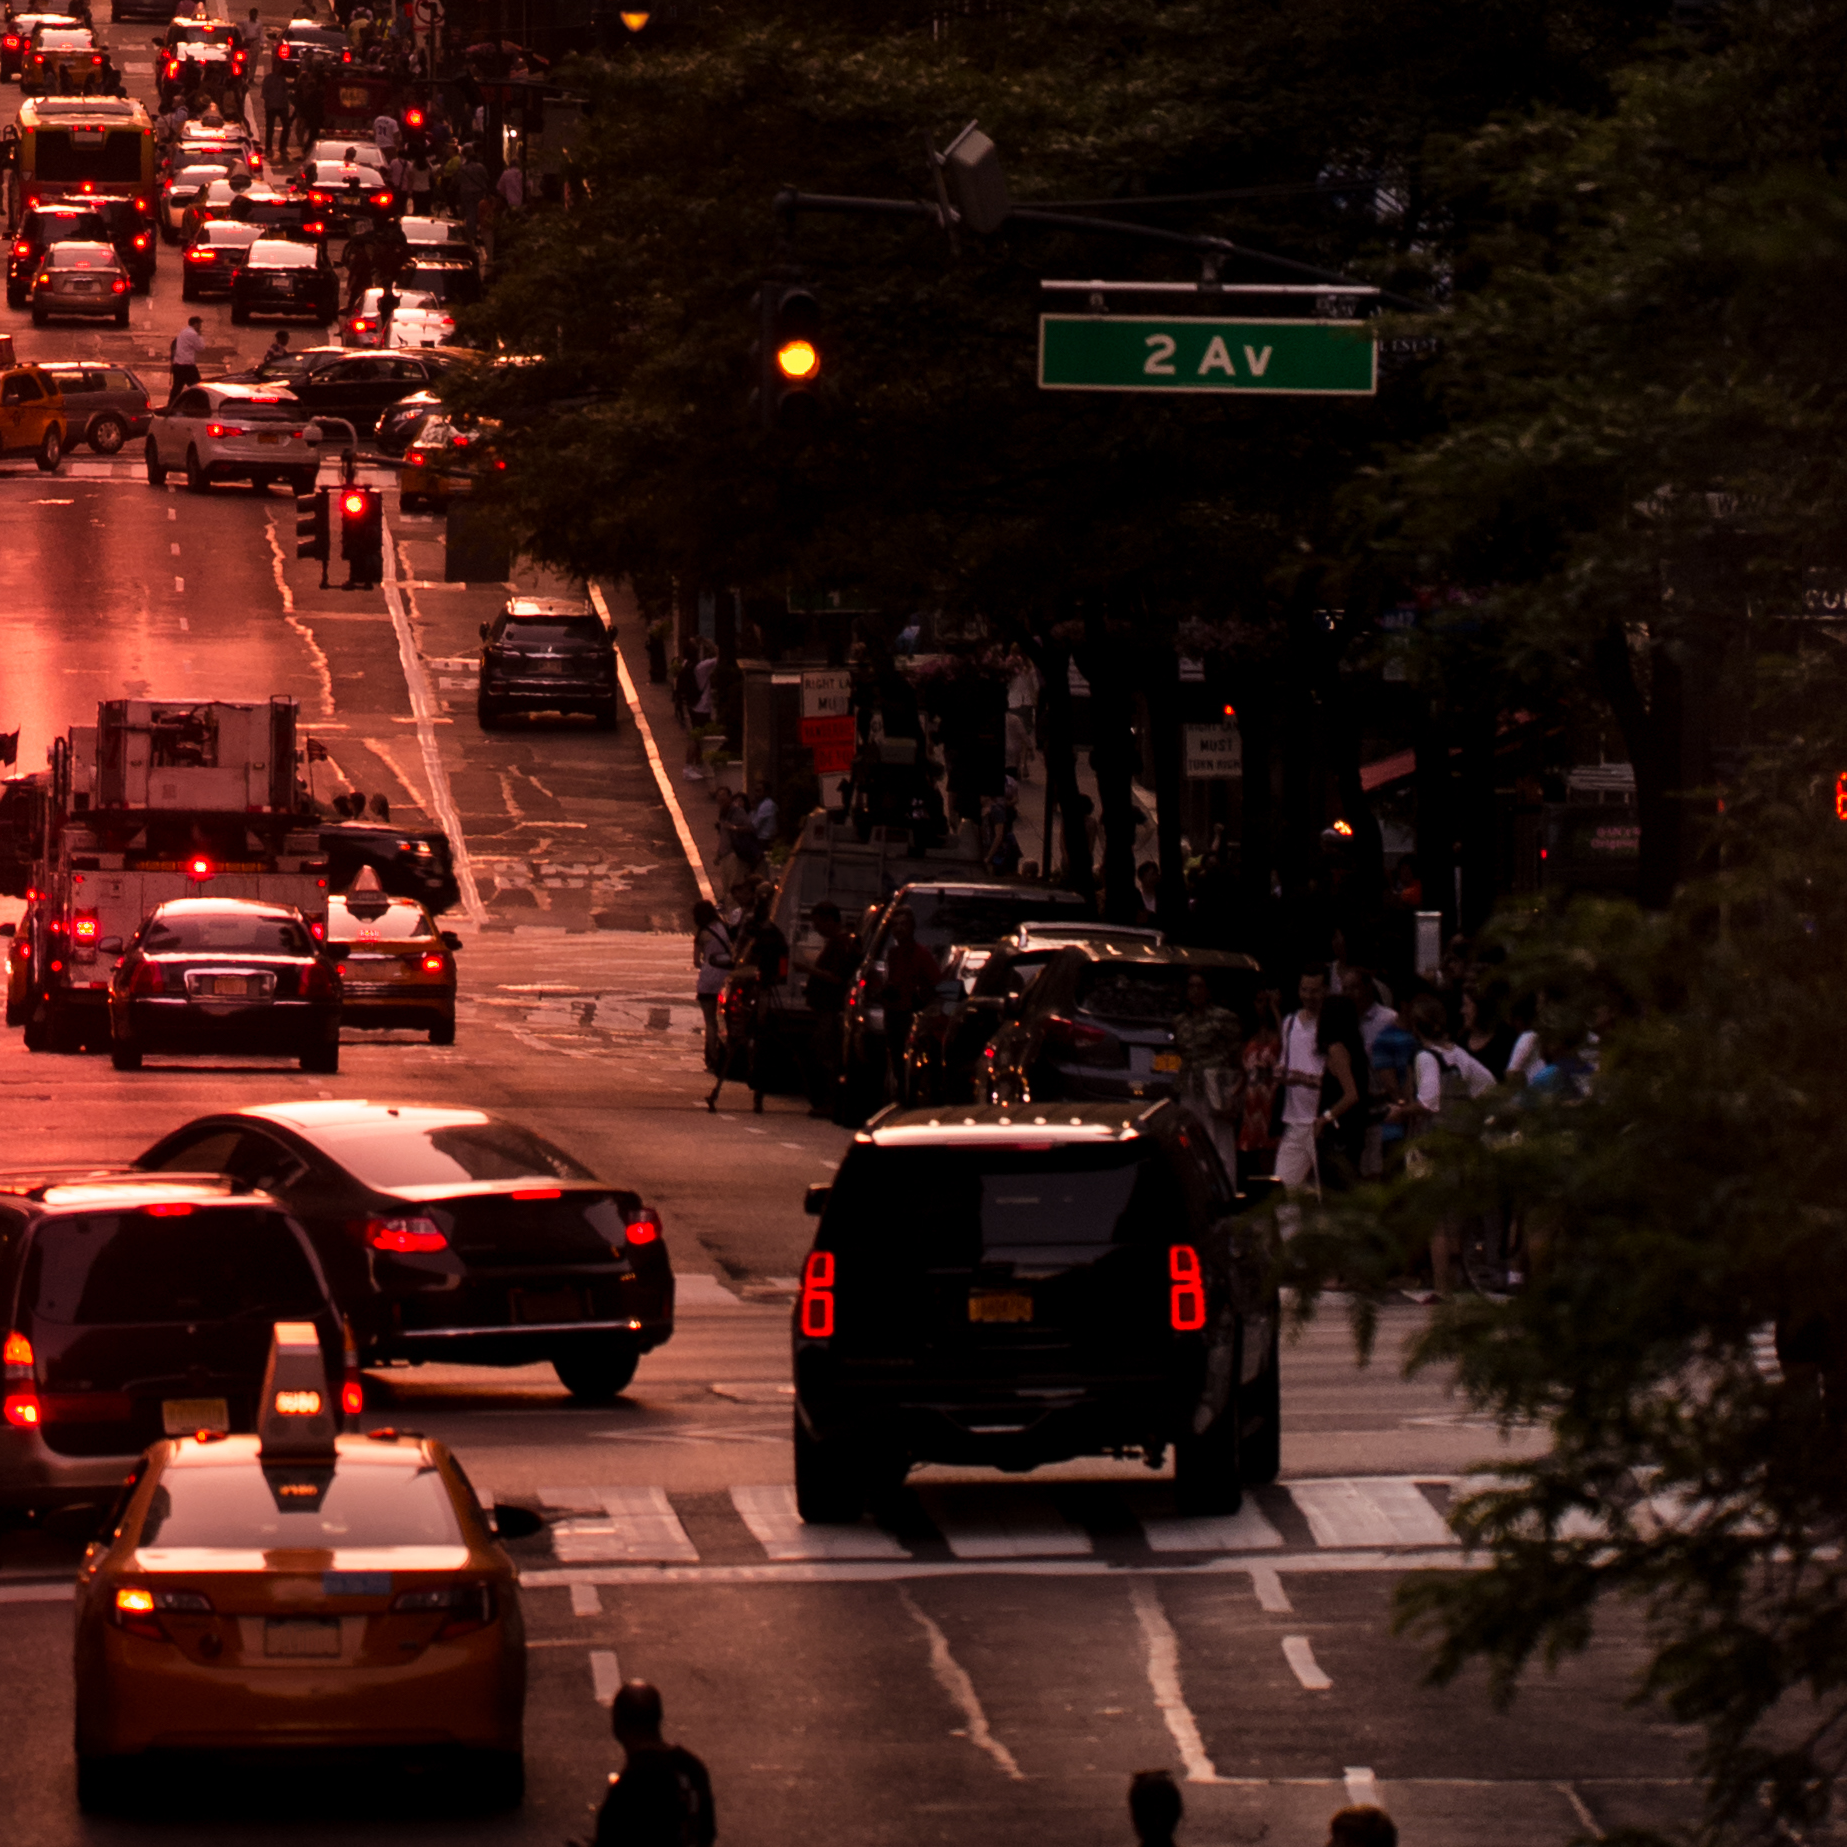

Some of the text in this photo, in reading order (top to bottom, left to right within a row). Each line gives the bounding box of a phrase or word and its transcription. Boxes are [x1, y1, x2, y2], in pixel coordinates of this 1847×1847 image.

[1143, 333, 1273, 376] 2 Av
[105, 727, 121, 769] 7
[1200, 739, 1232, 751] MUST
